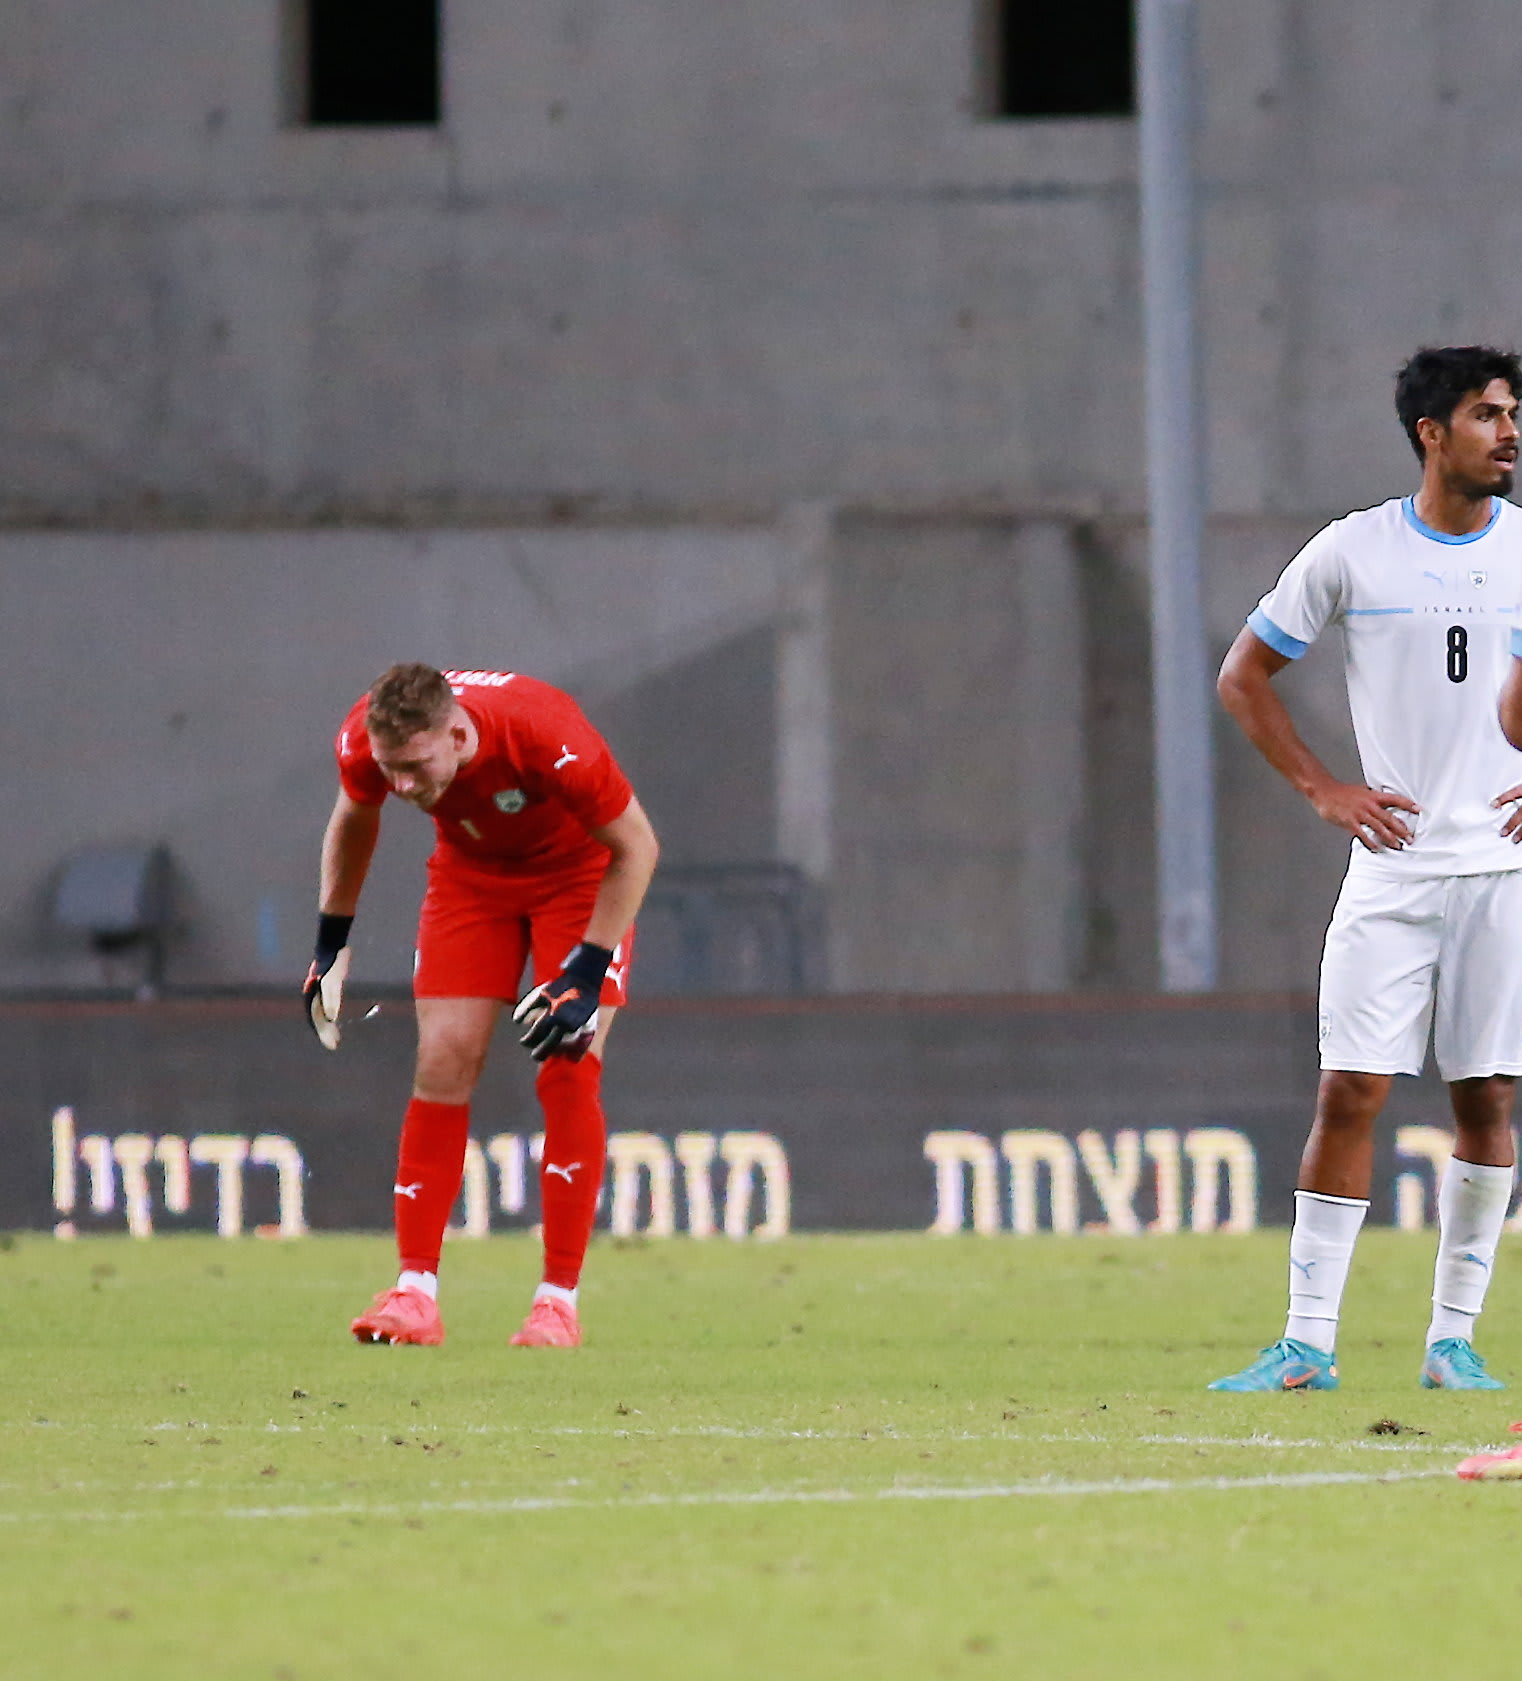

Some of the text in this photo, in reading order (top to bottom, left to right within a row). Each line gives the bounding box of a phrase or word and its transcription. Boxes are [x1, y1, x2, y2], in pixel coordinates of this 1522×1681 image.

[1446, 625, 1468, 683] 8
[460, 819, 482, 840] 1
[441, 1131, 791, 1239] מזמי
[922, 1127, 1259, 1237] מנצחת
